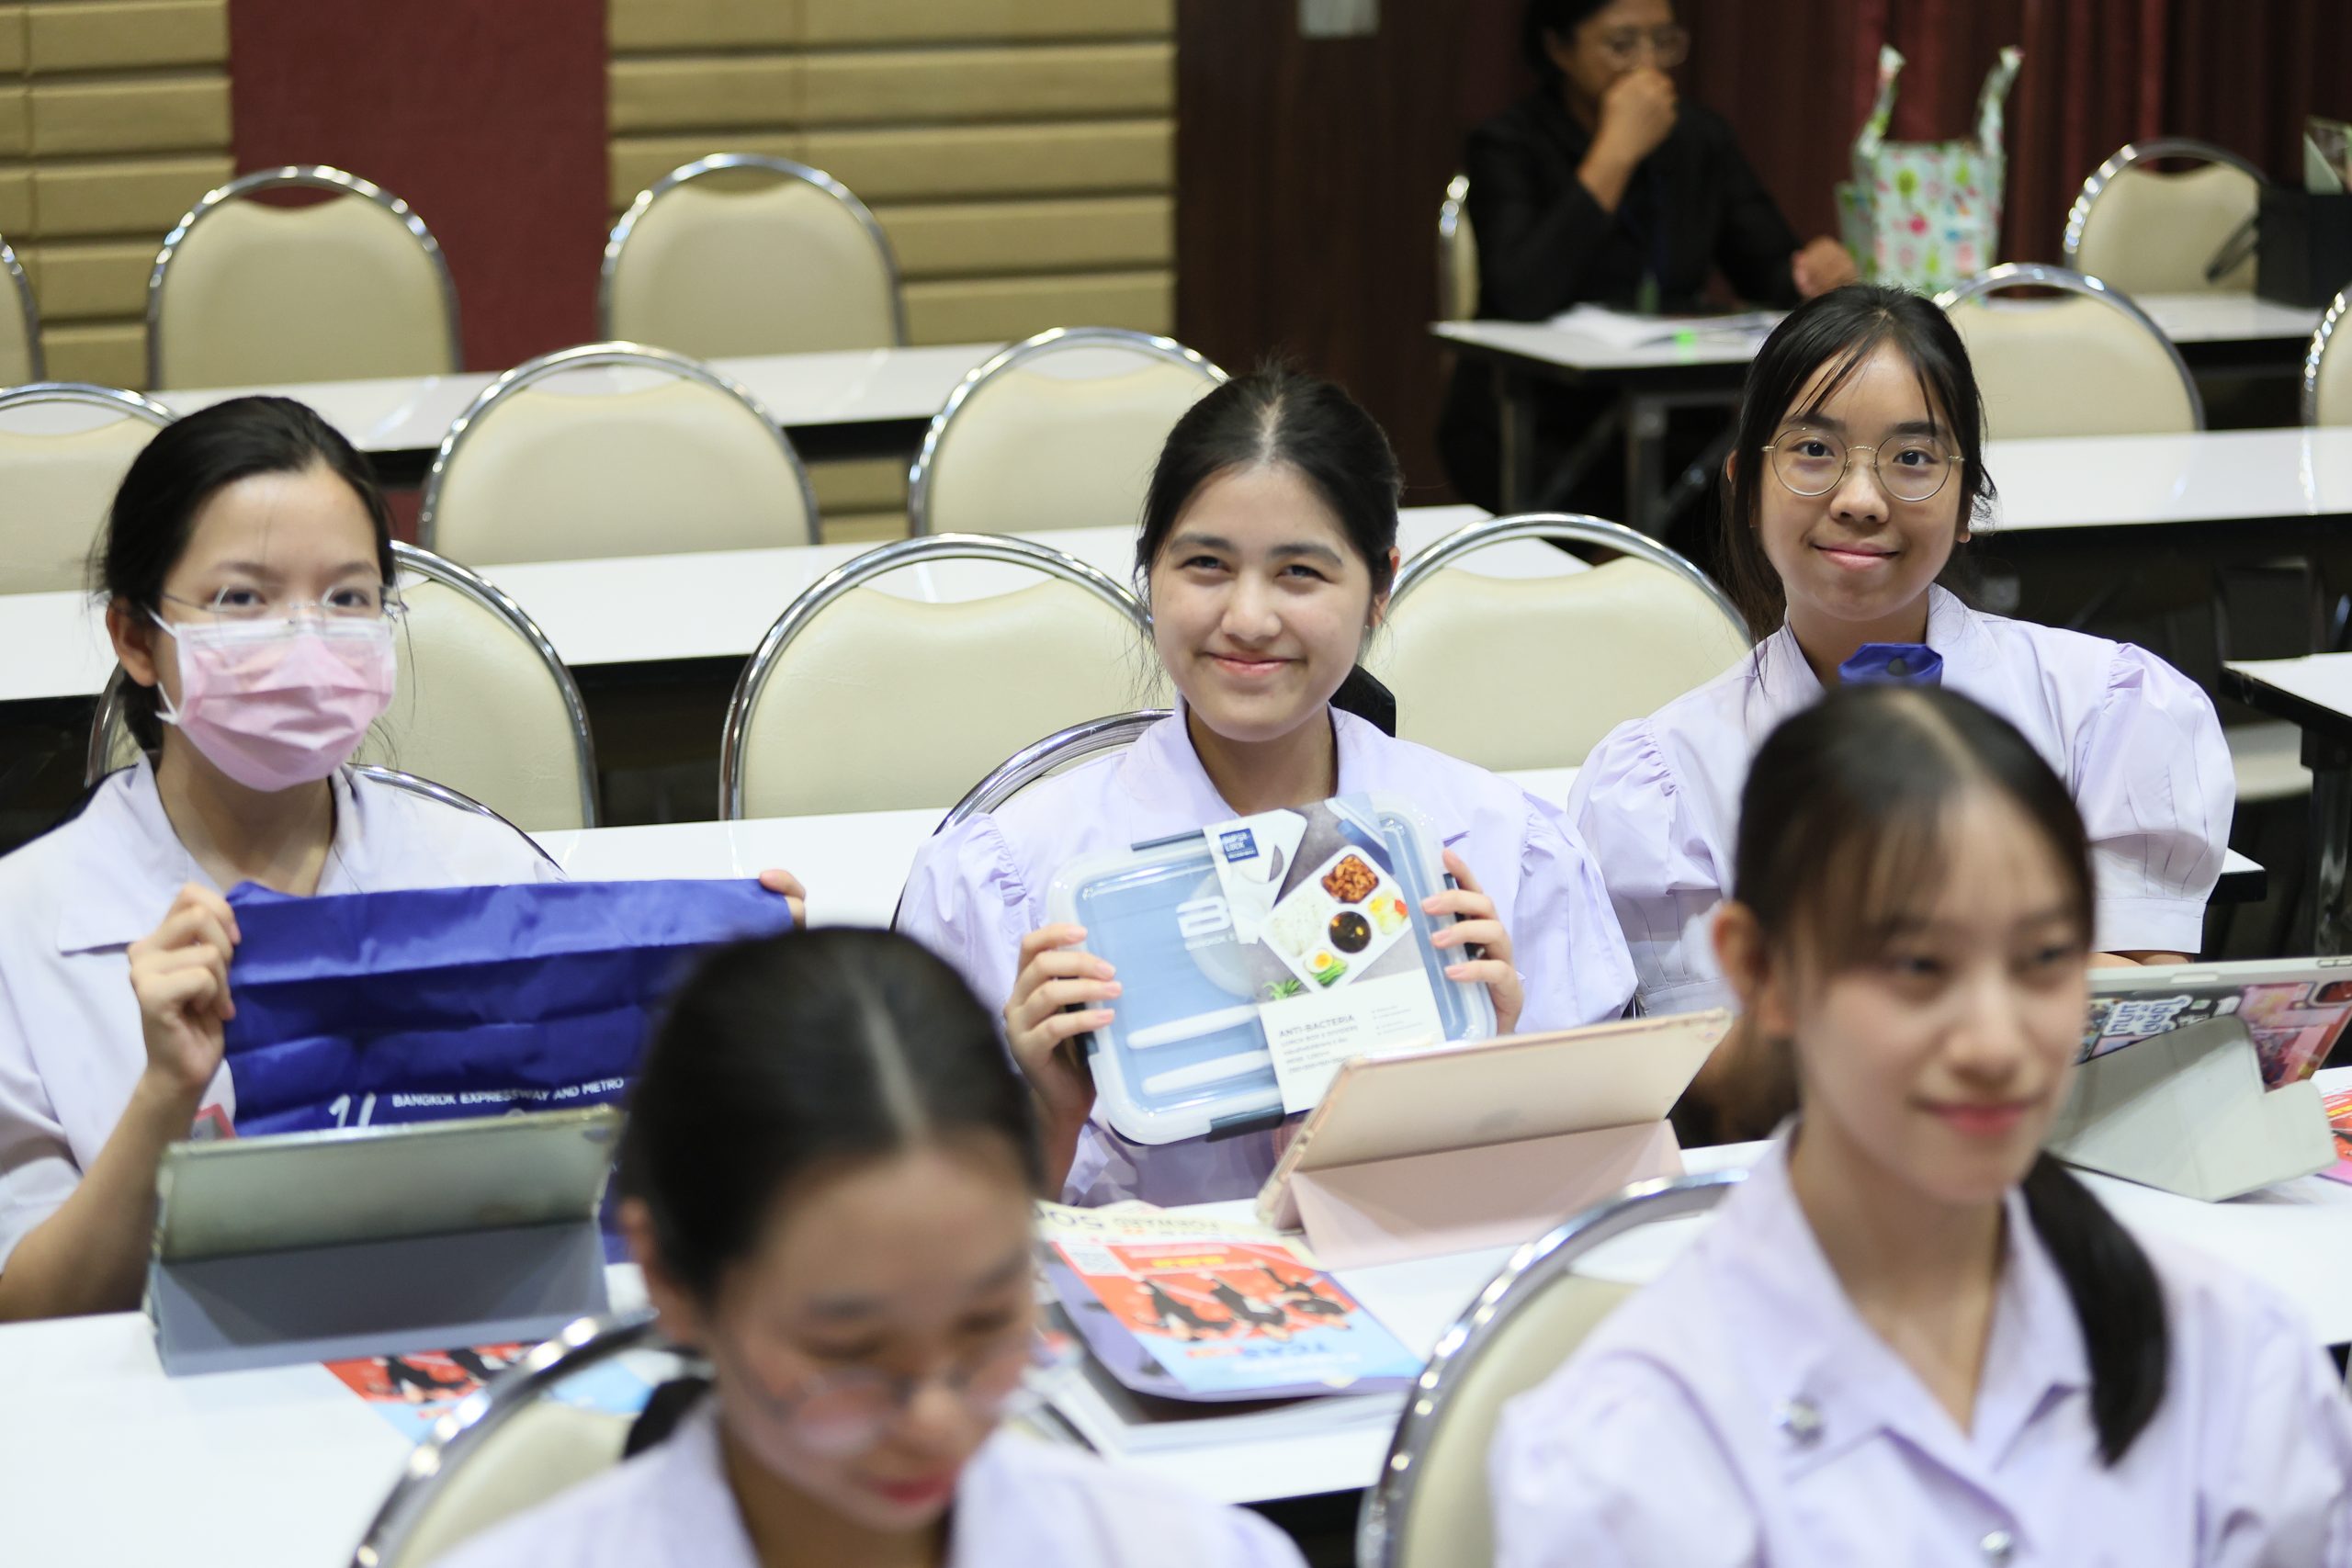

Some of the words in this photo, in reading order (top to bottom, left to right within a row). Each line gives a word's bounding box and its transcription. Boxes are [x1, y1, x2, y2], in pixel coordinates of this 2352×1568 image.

[392, 1093, 457, 1108] BANGKOK
[460, 1089, 549, 1104] EXPRESSWAY
[553, 1086, 580, 1100] AND
[582, 1077, 625, 1095] METRO
